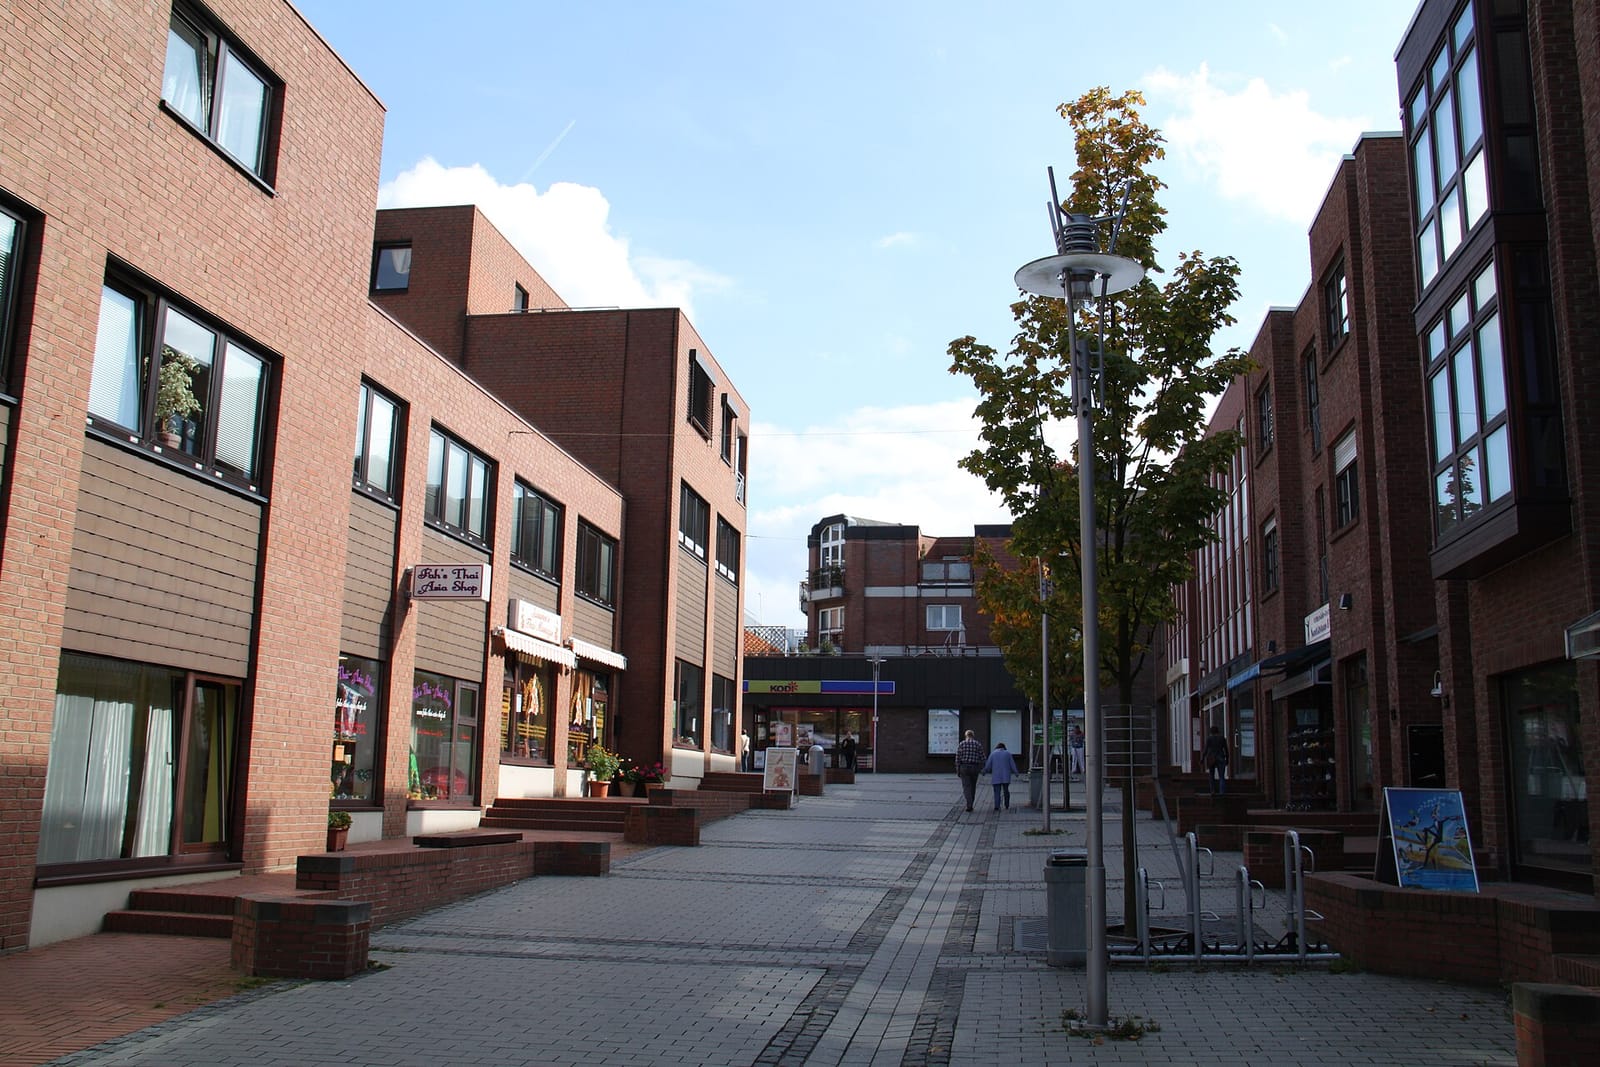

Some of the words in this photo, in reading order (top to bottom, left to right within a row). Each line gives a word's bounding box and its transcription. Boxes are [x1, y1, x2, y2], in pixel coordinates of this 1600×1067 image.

[451, 567, 479, 579] Thai
[417, 580, 448, 595] Asia
[451, 580, 478, 595] Shop
